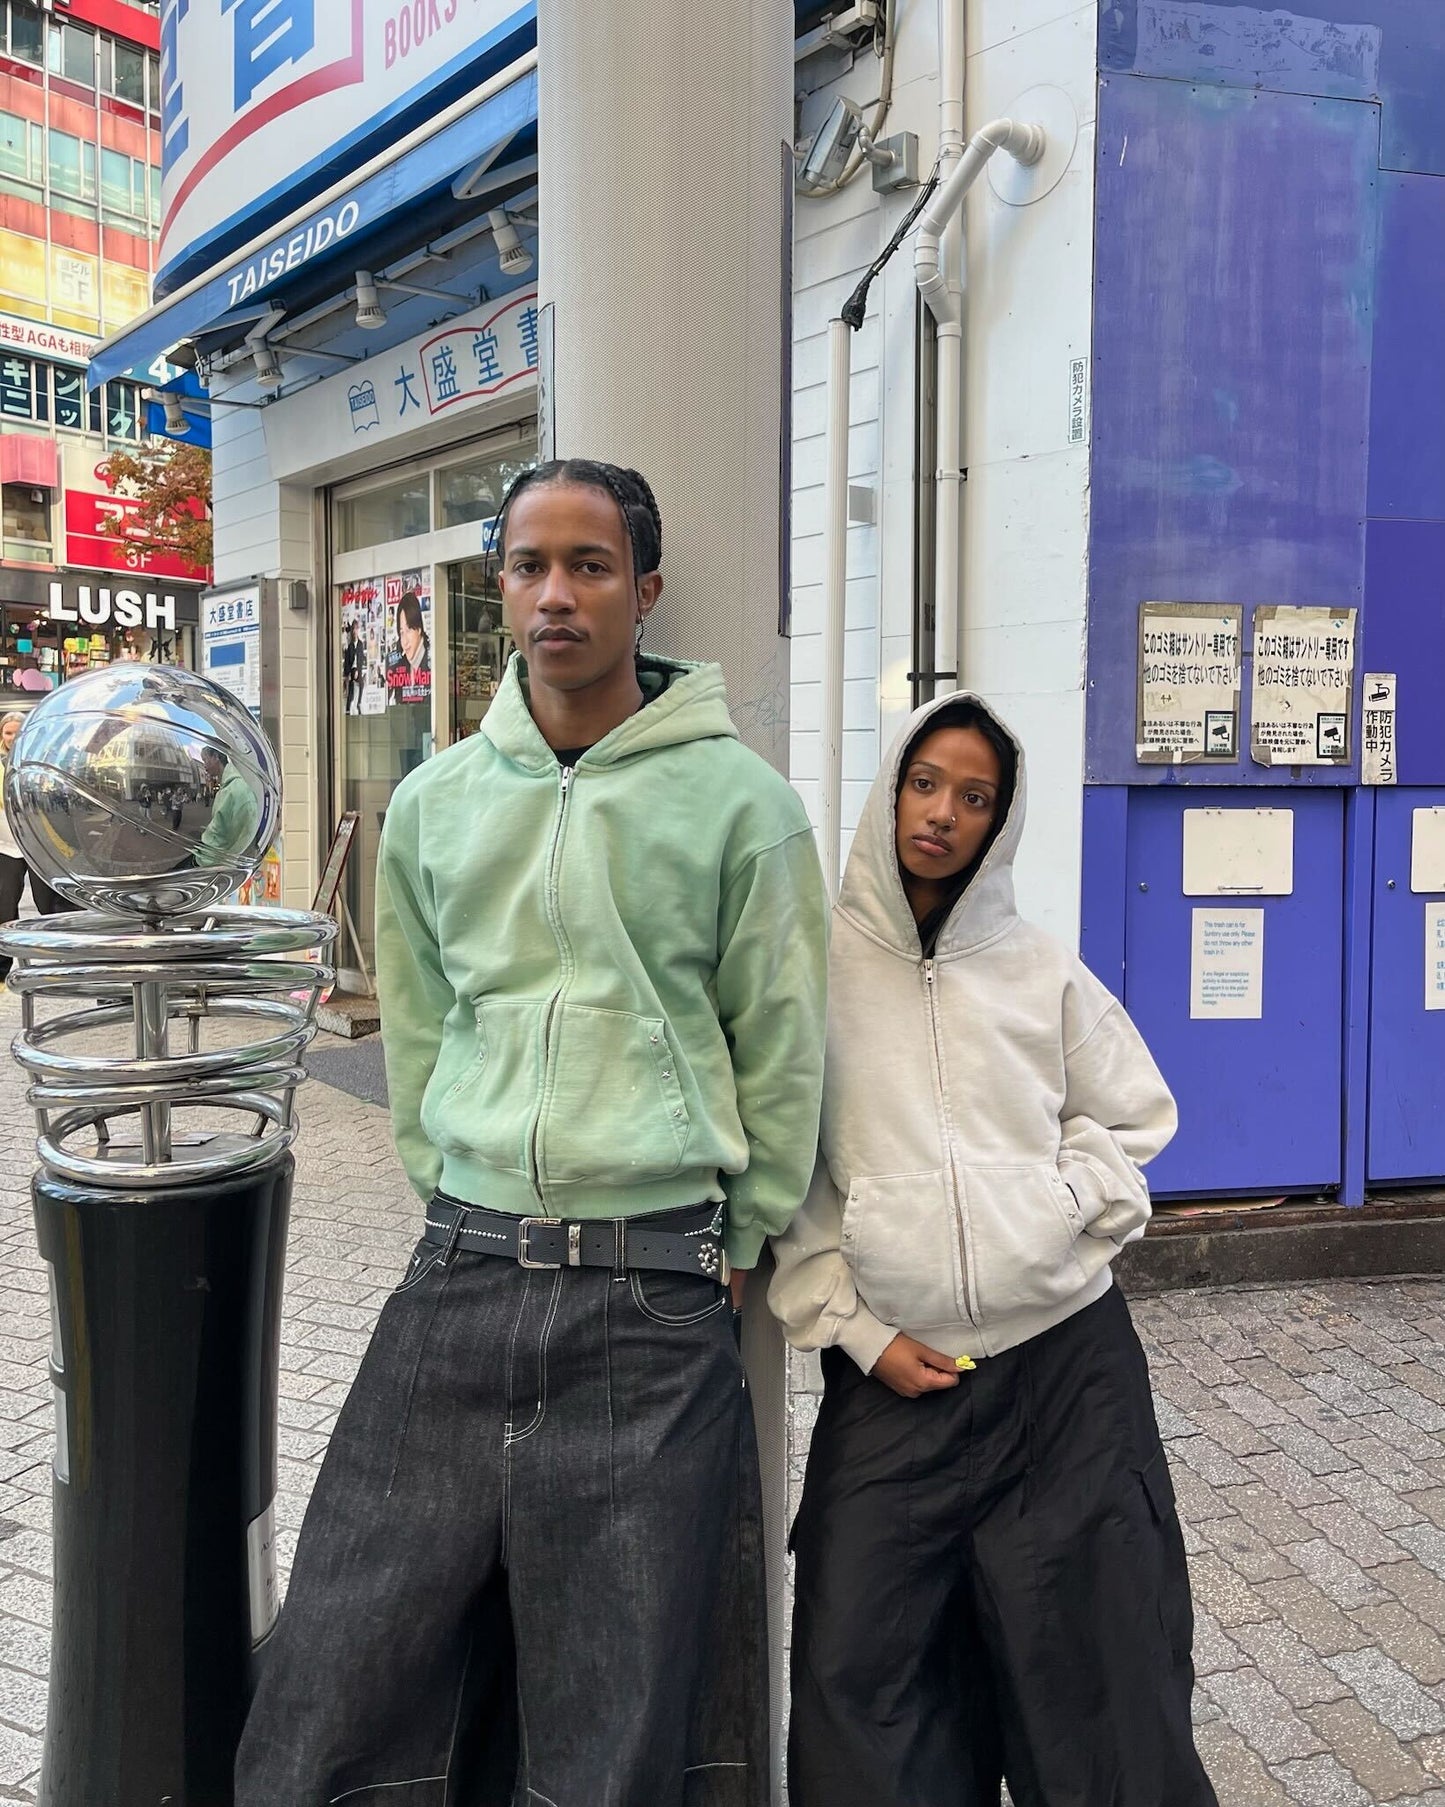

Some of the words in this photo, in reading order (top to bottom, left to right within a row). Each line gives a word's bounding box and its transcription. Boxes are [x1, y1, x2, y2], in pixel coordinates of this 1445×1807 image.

[228, 201, 359, 305] TAISEIDO
[1072, 361, 1084, 441] 防犯カメラ設置
[126, 548, 153, 568] 3F
[50, 582, 175, 630] LUSH
[1258, 634, 1350, 661] このゴミ箱はサントリー専用です
[387, 669, 411, 689] Snow
[1366, 710, 1378, 753] 作動中
[1380, 710, 1393, 782] 防犯カメラ
